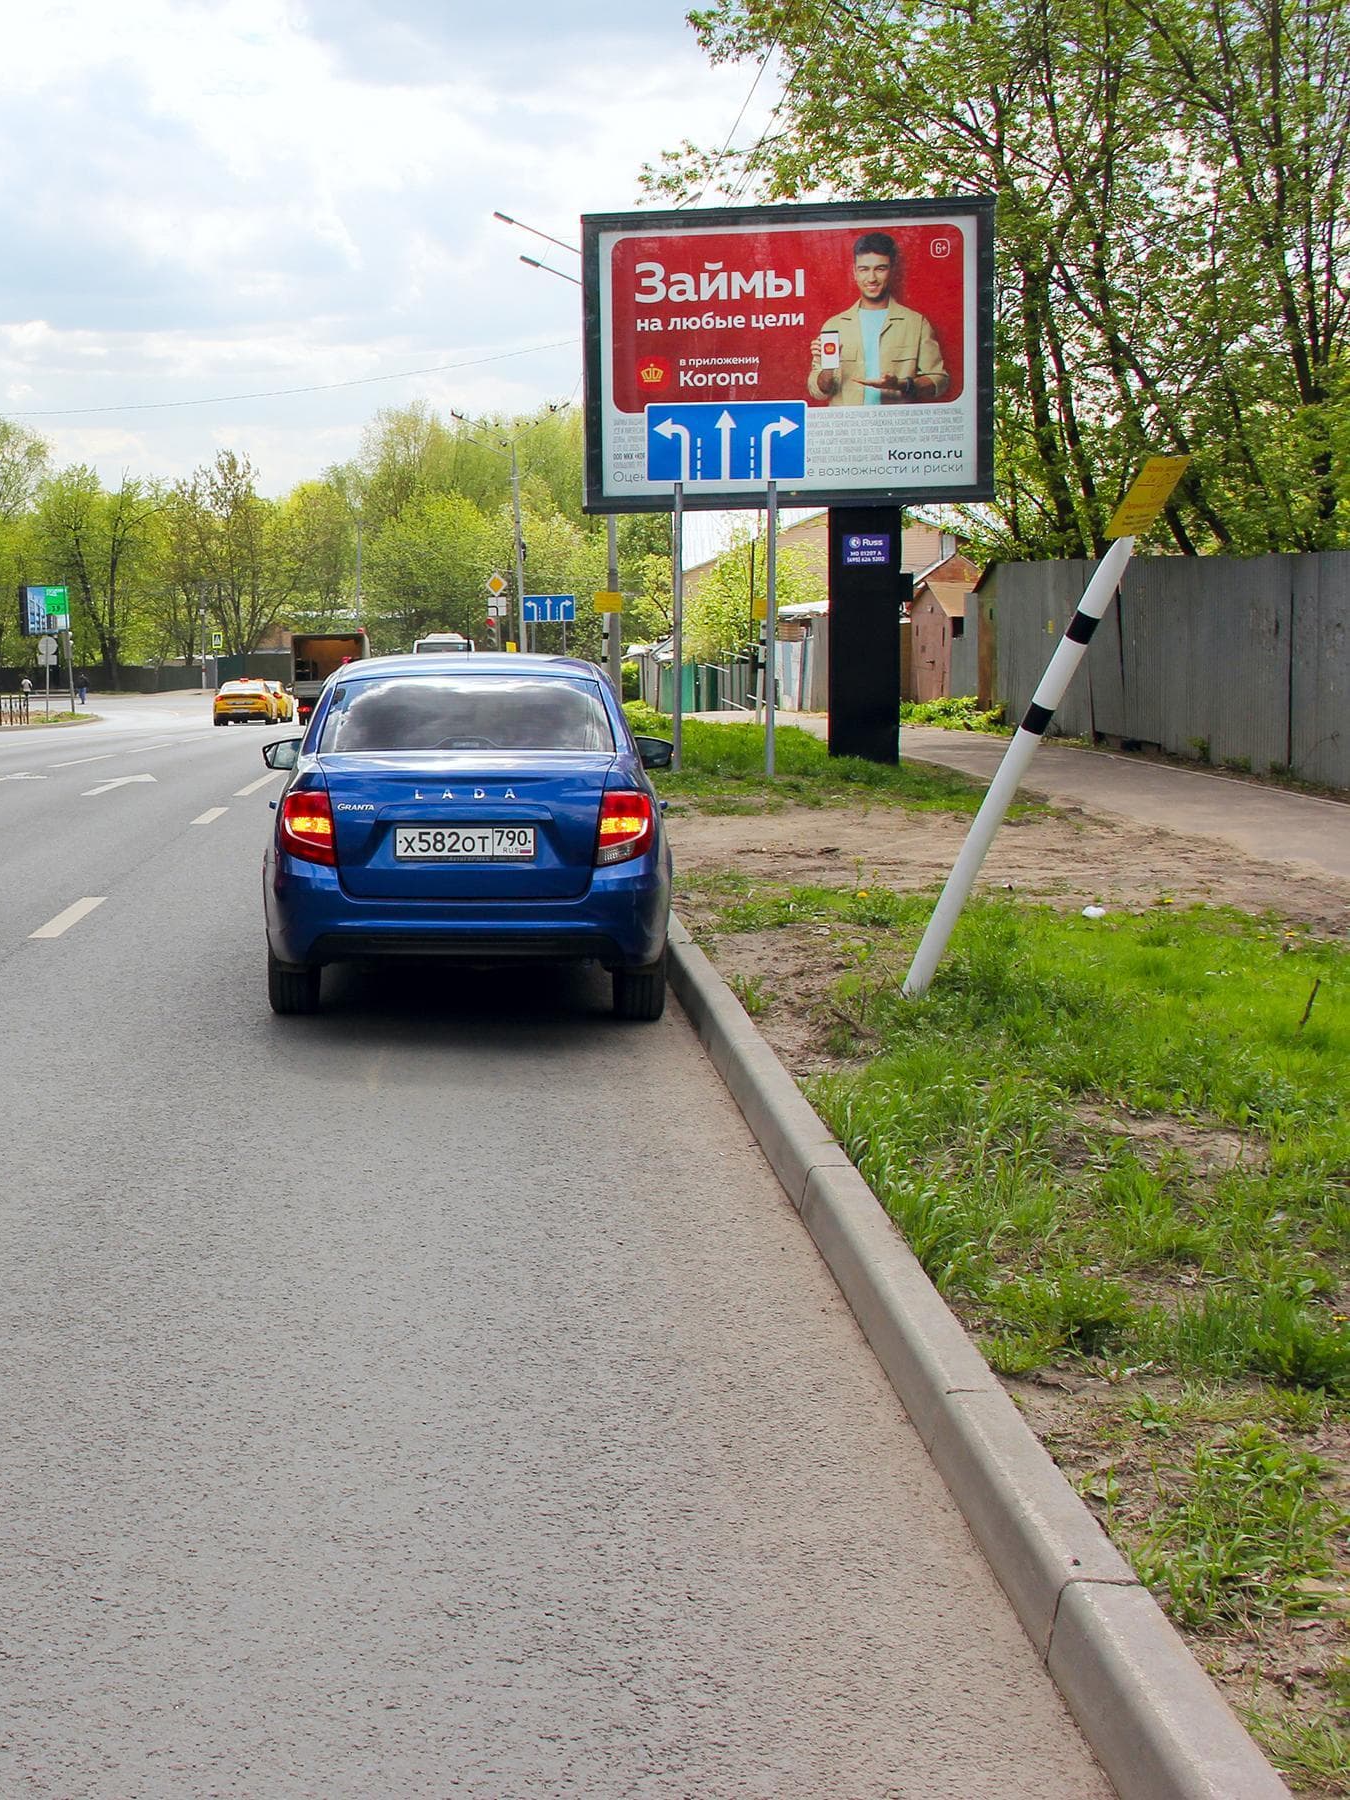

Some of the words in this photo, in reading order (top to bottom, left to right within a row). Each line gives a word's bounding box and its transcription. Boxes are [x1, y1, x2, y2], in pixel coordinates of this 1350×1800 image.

[935, 242, 947, 255] 6+
[634, 261, 805, 304] Займы
[636, 318, 662, 332] на
[668, 311, 746, 330] любые
[751, 312, 805, 330] цели
[680, 358, 686, 366] в
[688, 356, 760, 368] приложении
[680, 370, 758, 387] Korona
[888, 449, 963, 461] Korona.ru
[818, 464, 908, 477] возможности
[912, 465, 920, 474] и
[923, 463, 963, 476] риски
[862, 538, 883, 546] Russ
[414, 787, 516, 800] LADA
[494, 830, 528, 847] 790
